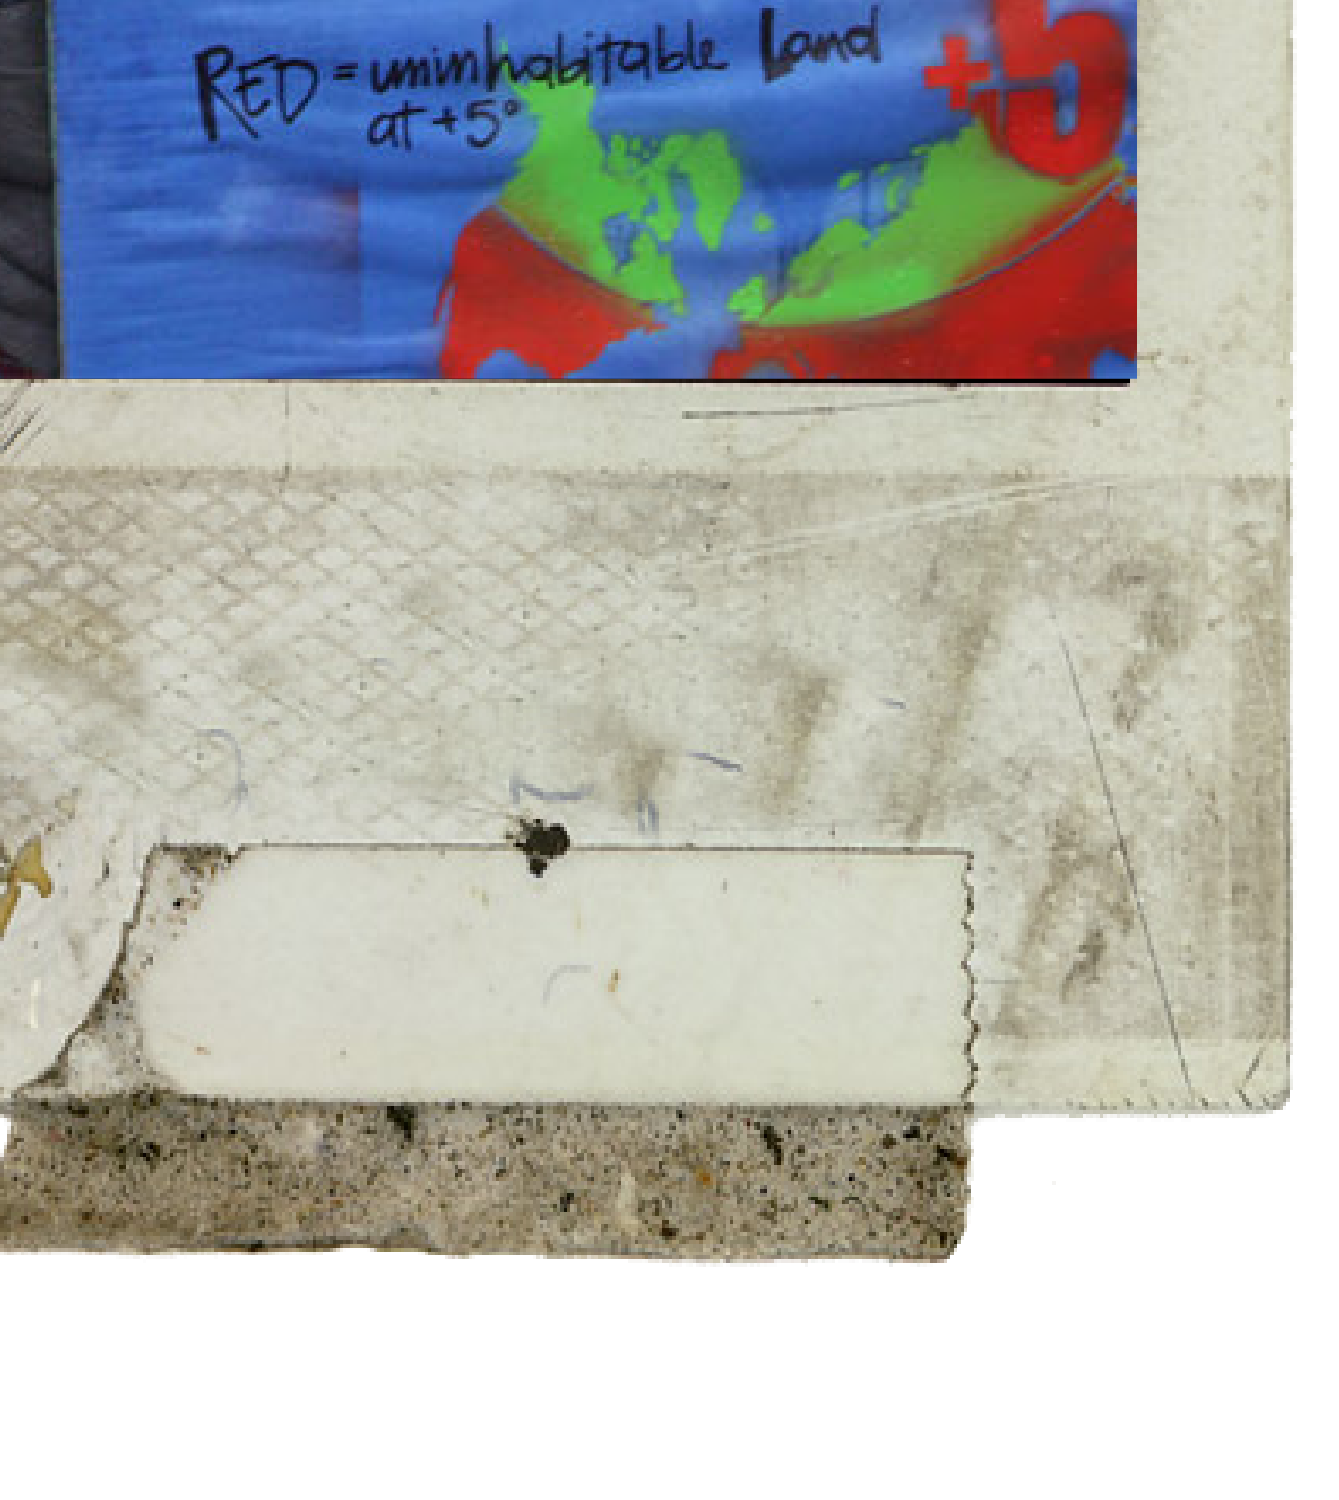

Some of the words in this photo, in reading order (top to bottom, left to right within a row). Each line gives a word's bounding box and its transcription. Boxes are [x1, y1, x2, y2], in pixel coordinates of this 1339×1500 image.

[196, 45, 320, 142] RED
[369, 18, 730, 95] uninhabitable
[367, 99, 428, 151] at
